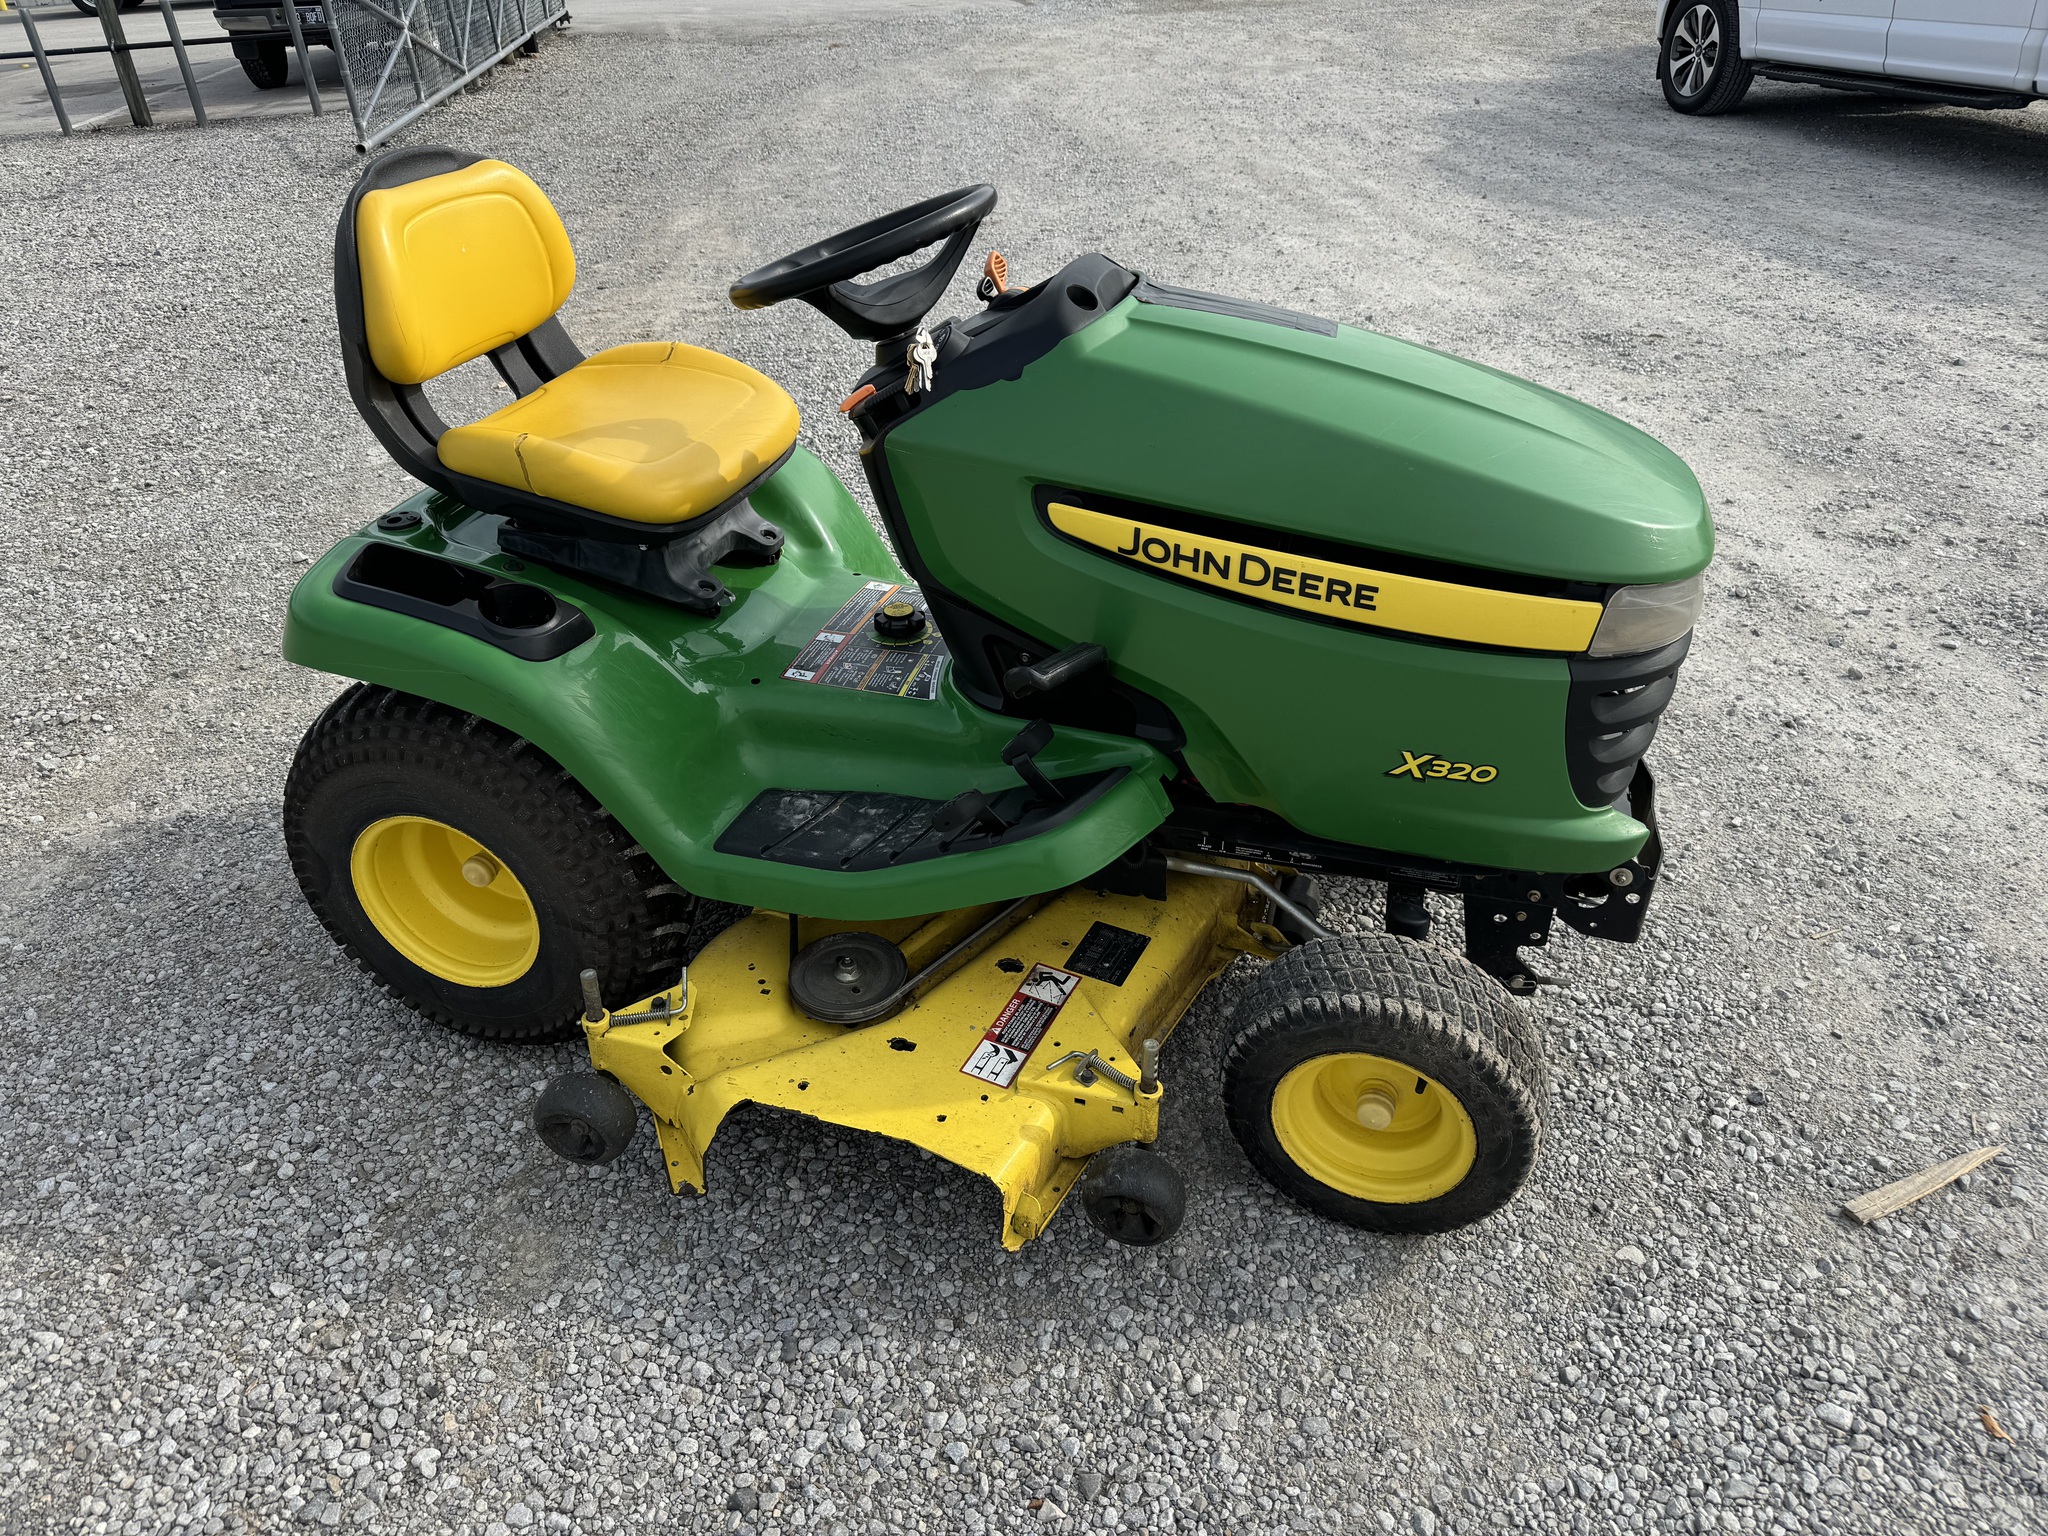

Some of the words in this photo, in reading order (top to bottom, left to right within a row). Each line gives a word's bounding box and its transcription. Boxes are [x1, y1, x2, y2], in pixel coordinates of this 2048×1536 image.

[1117, 527, 1231, 580] JOHN
[1238, 552, 1380, 611] DEERE
[1384, 750, 1498, 784] X320
[996, 998, 1021, 1027] DANGER
